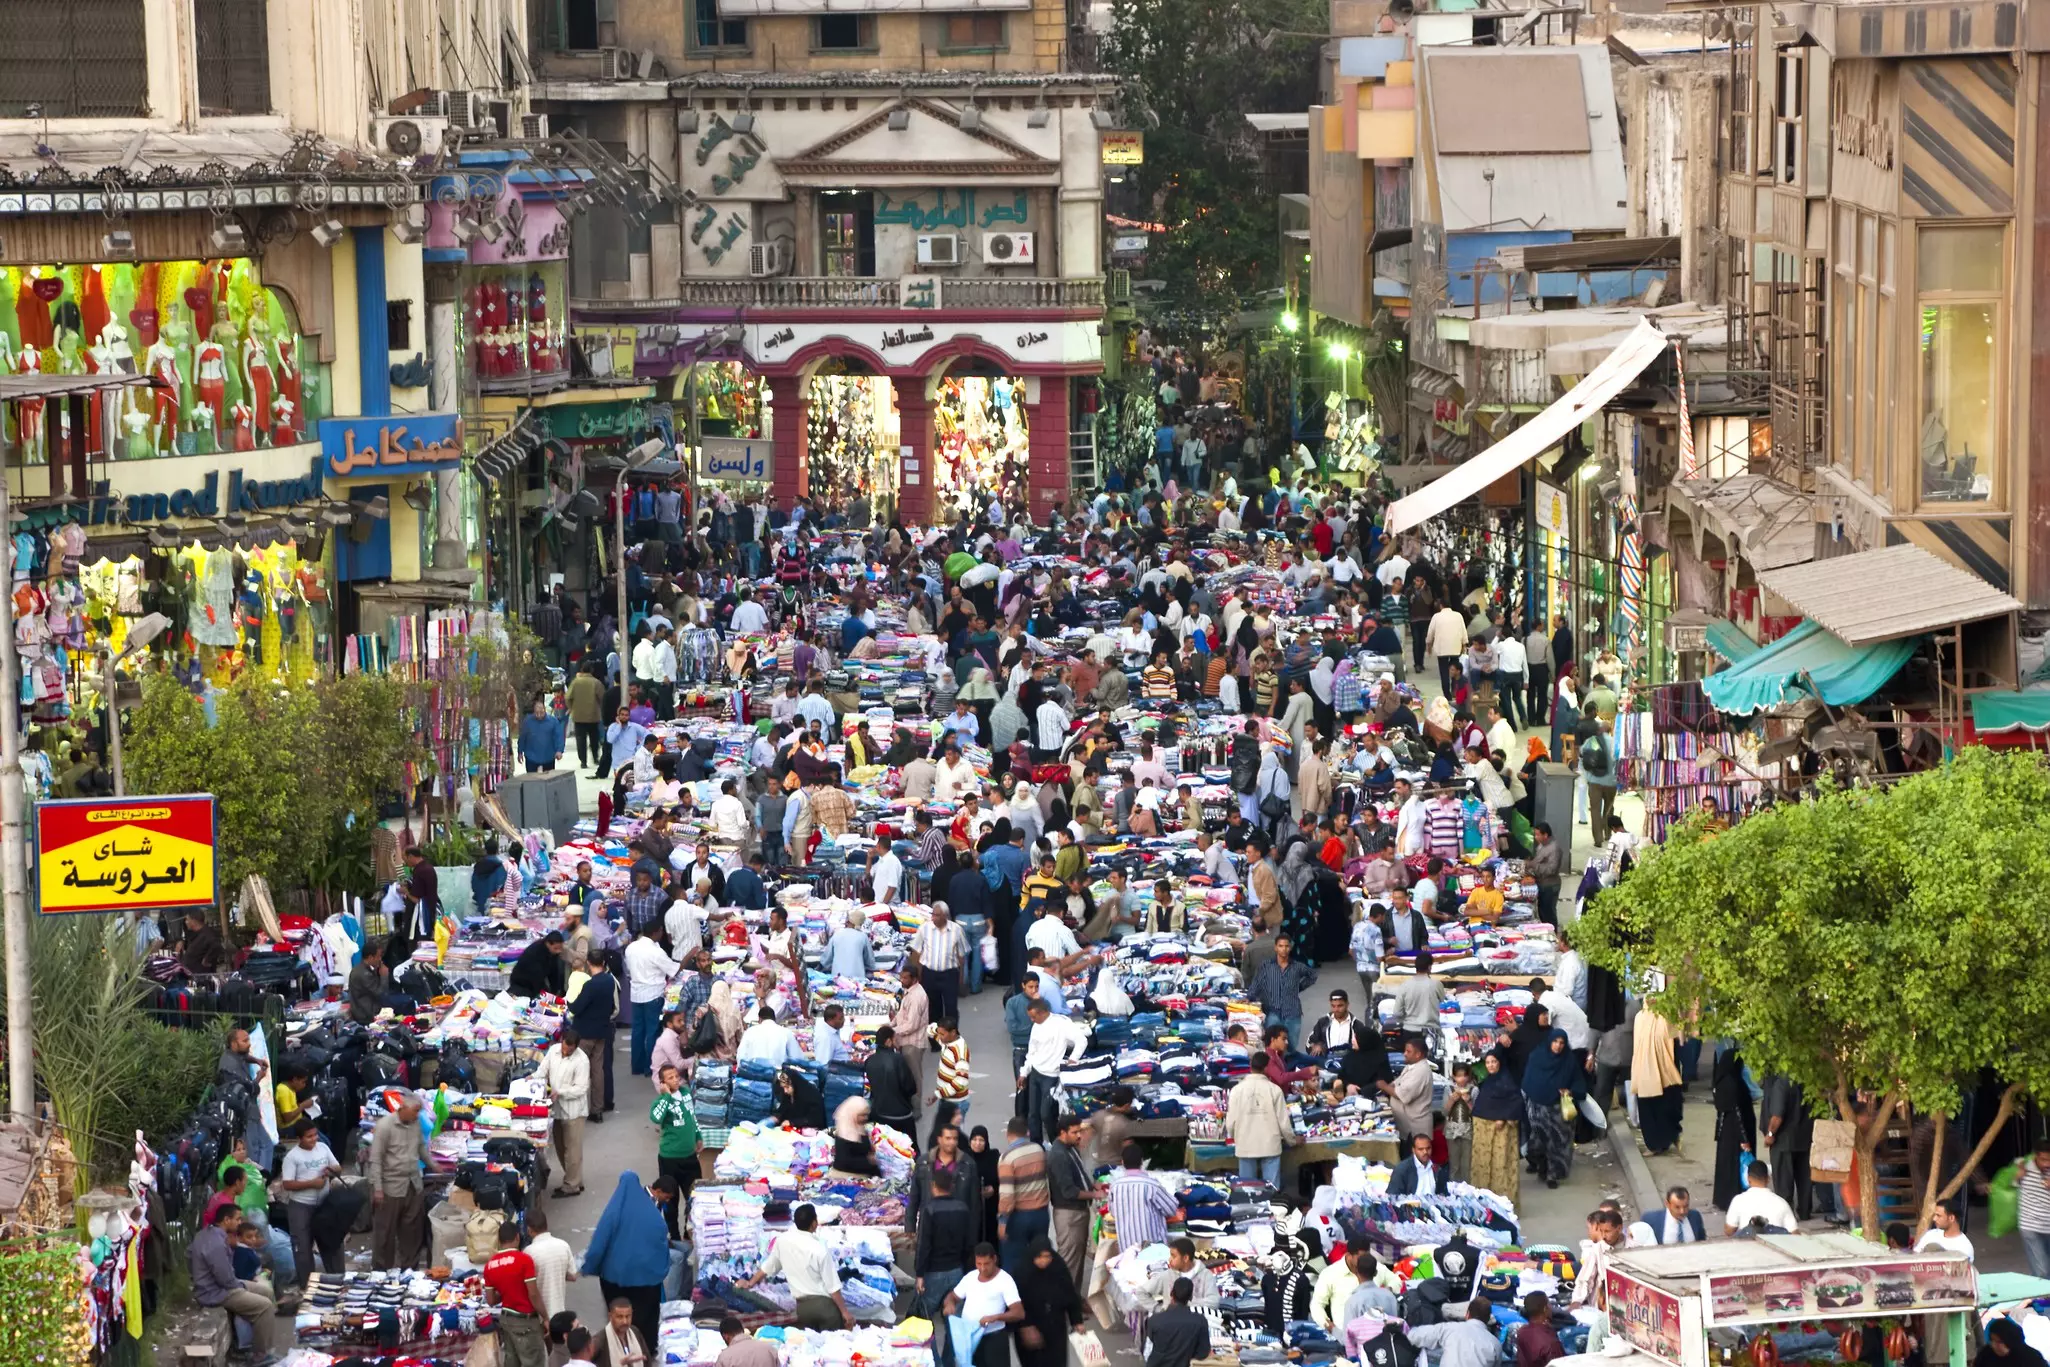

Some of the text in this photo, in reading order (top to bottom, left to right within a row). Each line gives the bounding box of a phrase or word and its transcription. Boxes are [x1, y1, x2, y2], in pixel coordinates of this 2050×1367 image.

[905, 324, 934, 344] شمس
[330, 425, 408, 475] كامل
[94, 837, 153, 861] شاى
[61, 857, 196, 895] العروسة
